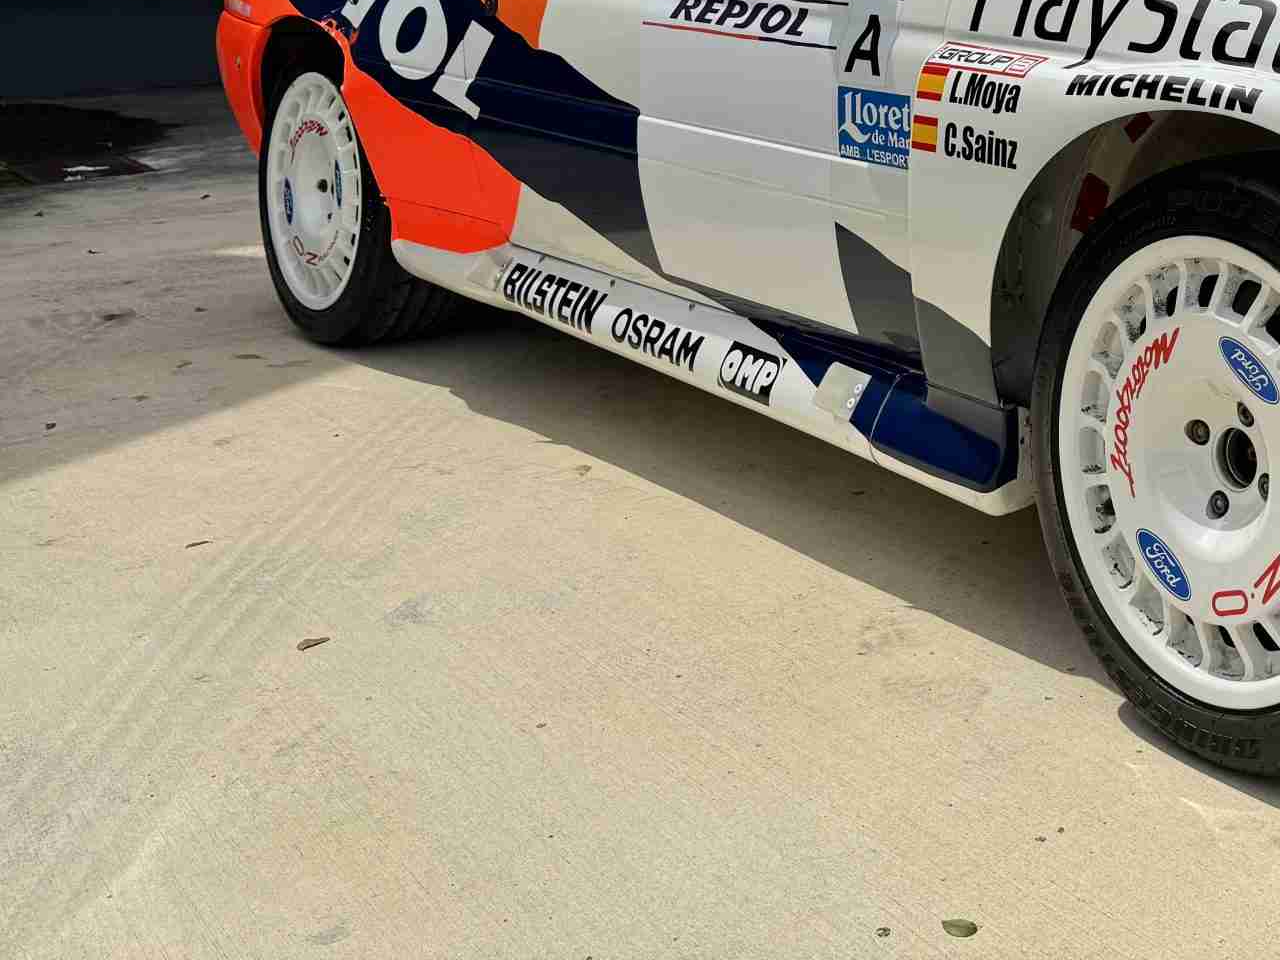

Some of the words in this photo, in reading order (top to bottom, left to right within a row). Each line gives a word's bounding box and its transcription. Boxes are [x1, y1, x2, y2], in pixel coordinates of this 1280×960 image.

[844, 14, 882, 77] A
[939, 47, 1015, 66] GROUP
[949, 71, 1022, 114] L.Moya
[1064, 73, 1265, 115] MICHELIN
[839, 91, 911, 143] Lloret
[871, 130, 885, 145] de
[887, 131, 911, 149] Mar
[840, 144, 861, 158] AMB
[944, 122, 1018, 170] C.Sainz
[502, 263, 608, 335] BILSTEIN
[611, 308, 706, 372] OSRAM
[721, 349, 779, 394] OMP
[1230, 346, 1269, 396] Ford
[1145, 540, 1183, 591] Ford
